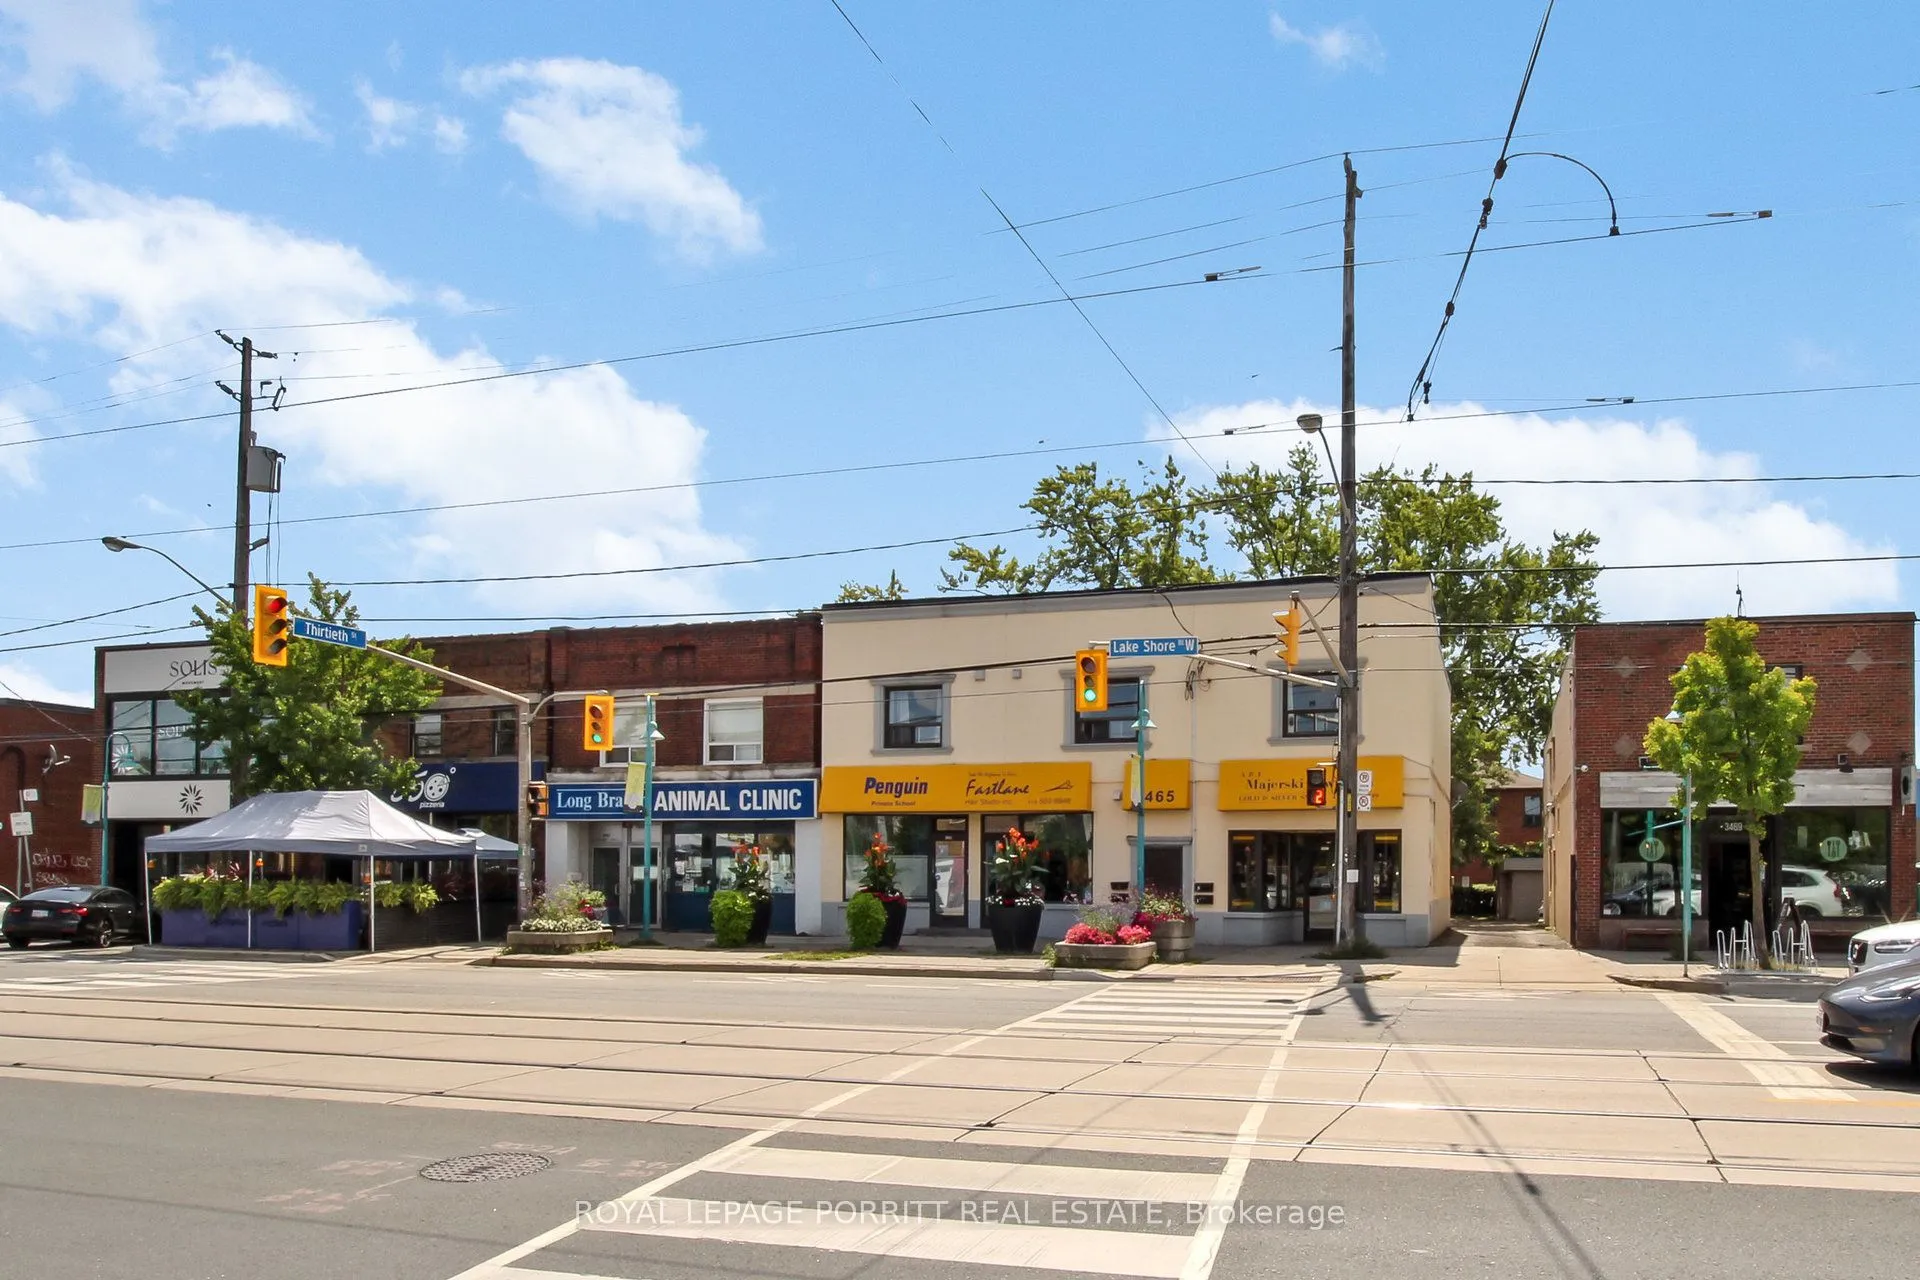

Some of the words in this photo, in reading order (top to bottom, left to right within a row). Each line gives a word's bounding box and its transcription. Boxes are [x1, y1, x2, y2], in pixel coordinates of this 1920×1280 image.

[304, 621, 349, 643] Thirtieth
[1113, 640, 1139, 653] Lake
[1143, 639, 1176, 653] Shore
[1185, 638, 1195, 652] W
[169, 659, 217, 678] SOLIS
[864, 776, 928, 799] Penguin
[965, 779, 1030, 797] Fastlane
[1144, 790, 1175, 803] 465
[557, 791, 592, 811] Long
[597, 791, 624, 809] Bra
[653, 789, 731, 812] ANIMAL
[738, 788, 802, 811] CLINIC
